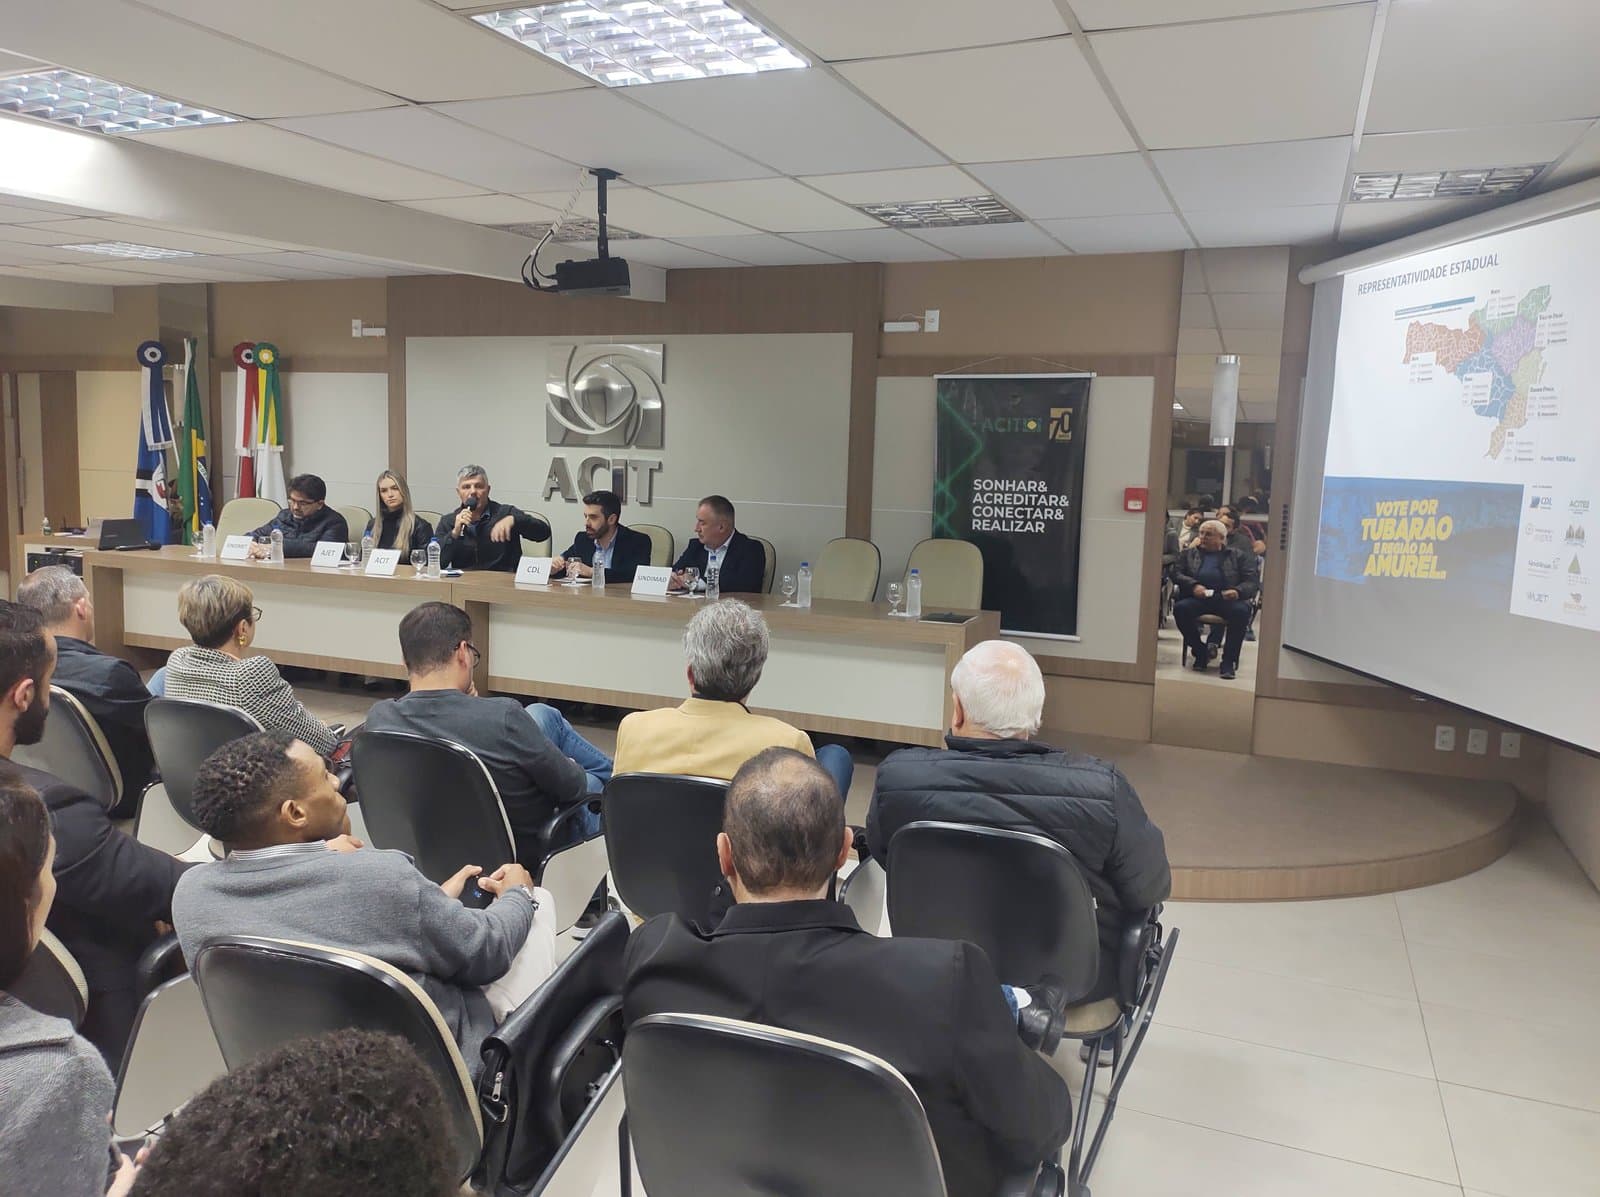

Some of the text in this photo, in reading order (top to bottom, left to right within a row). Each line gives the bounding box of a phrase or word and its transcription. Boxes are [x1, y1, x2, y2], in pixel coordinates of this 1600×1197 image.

[1357, 253, 1500, 296] REPRESENTATIVIDADE ESTADUAL
[542, 456, 663, 506] ACIT
[973, 479, 1048, 493] SONHAR&
[972, 493, 1069, 507] ACREDITAR&
[972, 506, 1065, 520] CONECTAR&
[1376, 499, 1439, 517] VOTE POR
[971, 519, 1045, 534] REALIZAR
[1418, 542, 1434, 554] DA
[527, 565, 541, 574] CDL
[1363, 554, 1447, 579] AMUREL.
